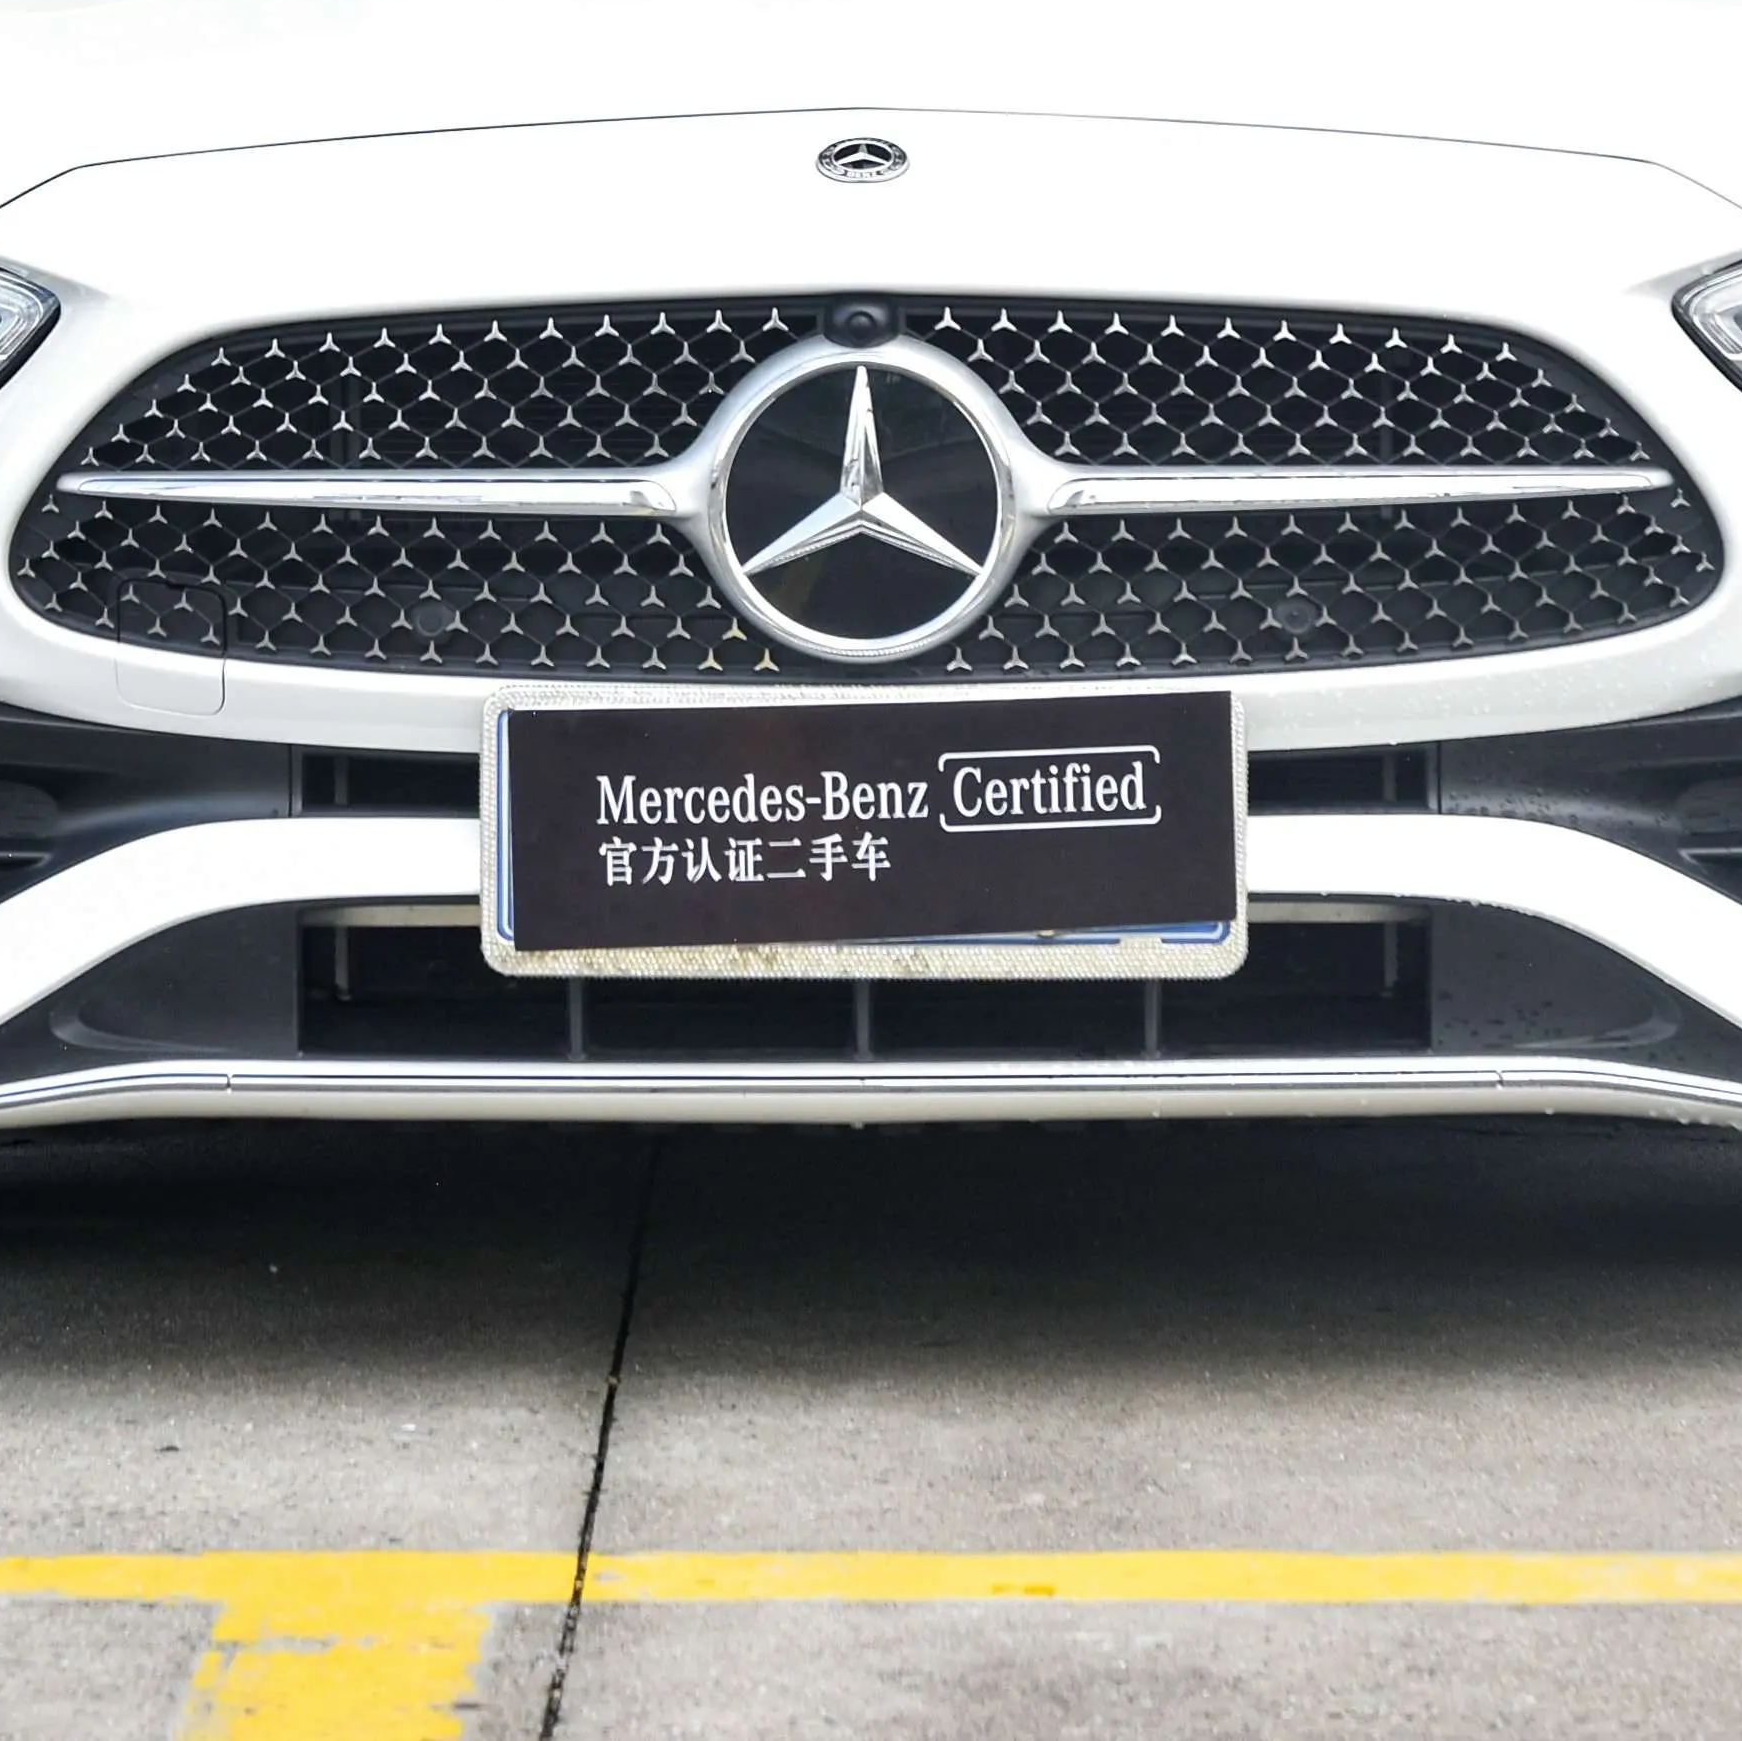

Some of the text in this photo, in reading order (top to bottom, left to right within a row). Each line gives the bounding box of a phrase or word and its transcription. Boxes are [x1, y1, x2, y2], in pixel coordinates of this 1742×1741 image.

[597, 762, 1146, 825] Mercedes-Benz Certified
[599, 832, 891, 885] 官方认证二手车
